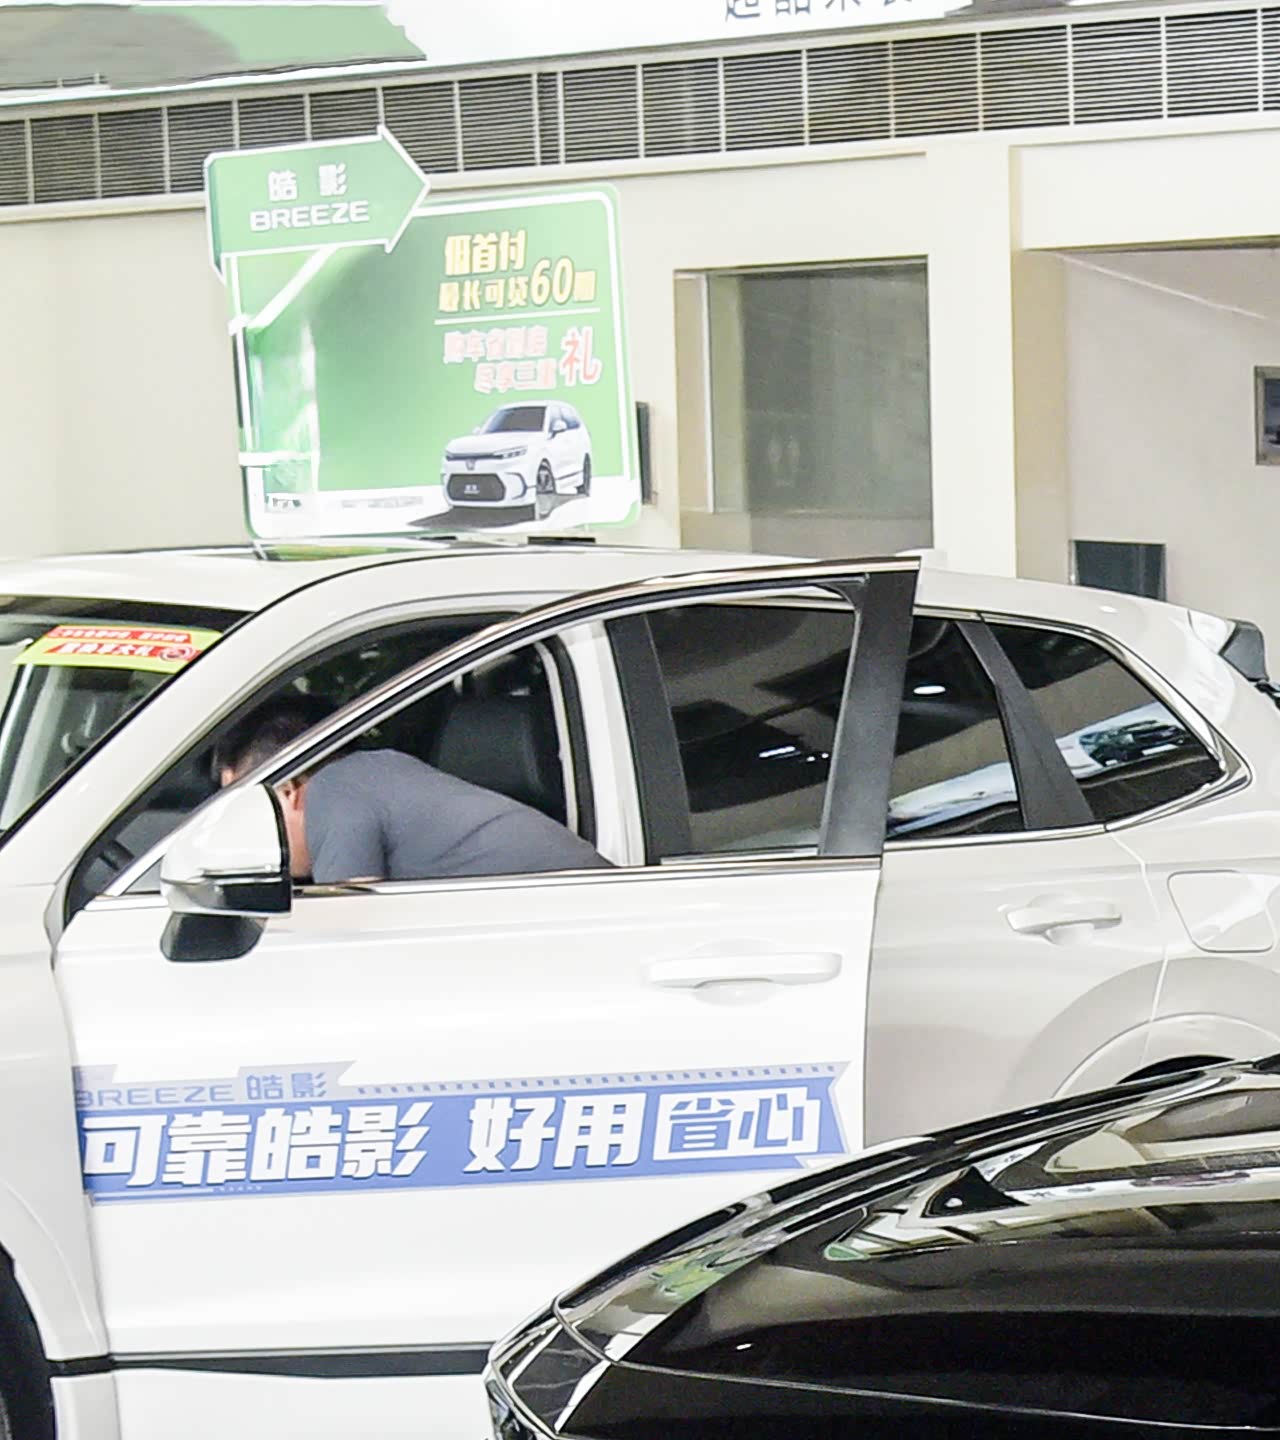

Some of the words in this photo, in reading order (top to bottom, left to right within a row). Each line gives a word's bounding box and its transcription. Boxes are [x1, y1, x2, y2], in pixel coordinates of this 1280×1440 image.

[249, 199, 370, 233] BREEZE
[76, 1084, 235, 1109] BREEZE
[246, 1071, 328, 1101] 皓影
[83, 1101, 434, 1188] 可靠皓影
[463, 1084, 822, 1173] 好用省心
